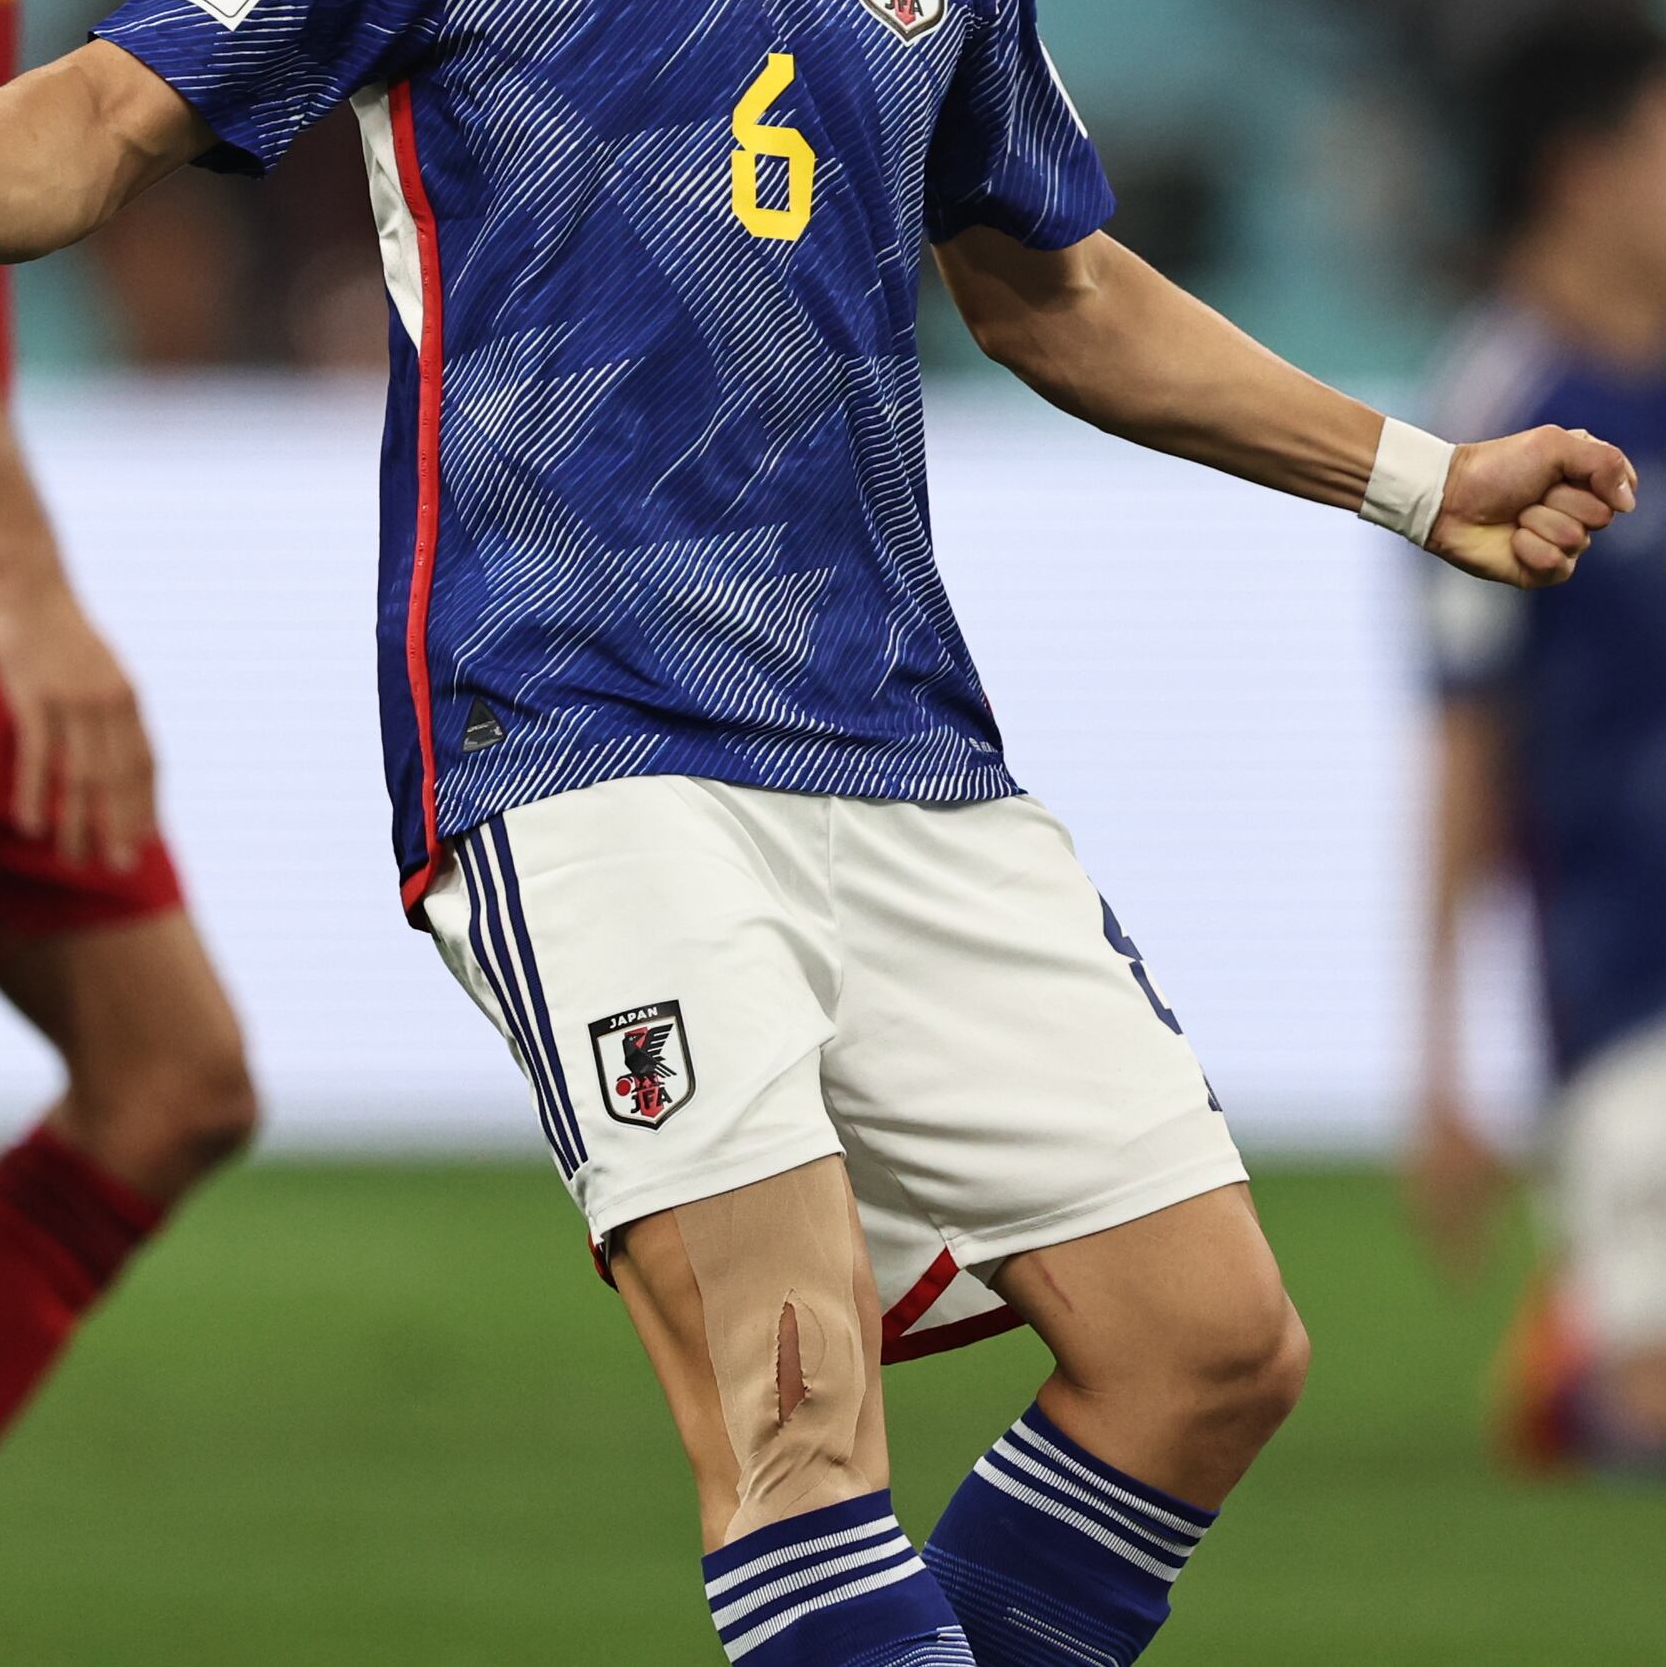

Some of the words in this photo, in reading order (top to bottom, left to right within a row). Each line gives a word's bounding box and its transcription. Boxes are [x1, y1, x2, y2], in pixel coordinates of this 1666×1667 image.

[731, 52, 816, 240] 6
[609, 1006, 659, 1030] JAPAN
[630, 1086, 673, 1114] JFA
